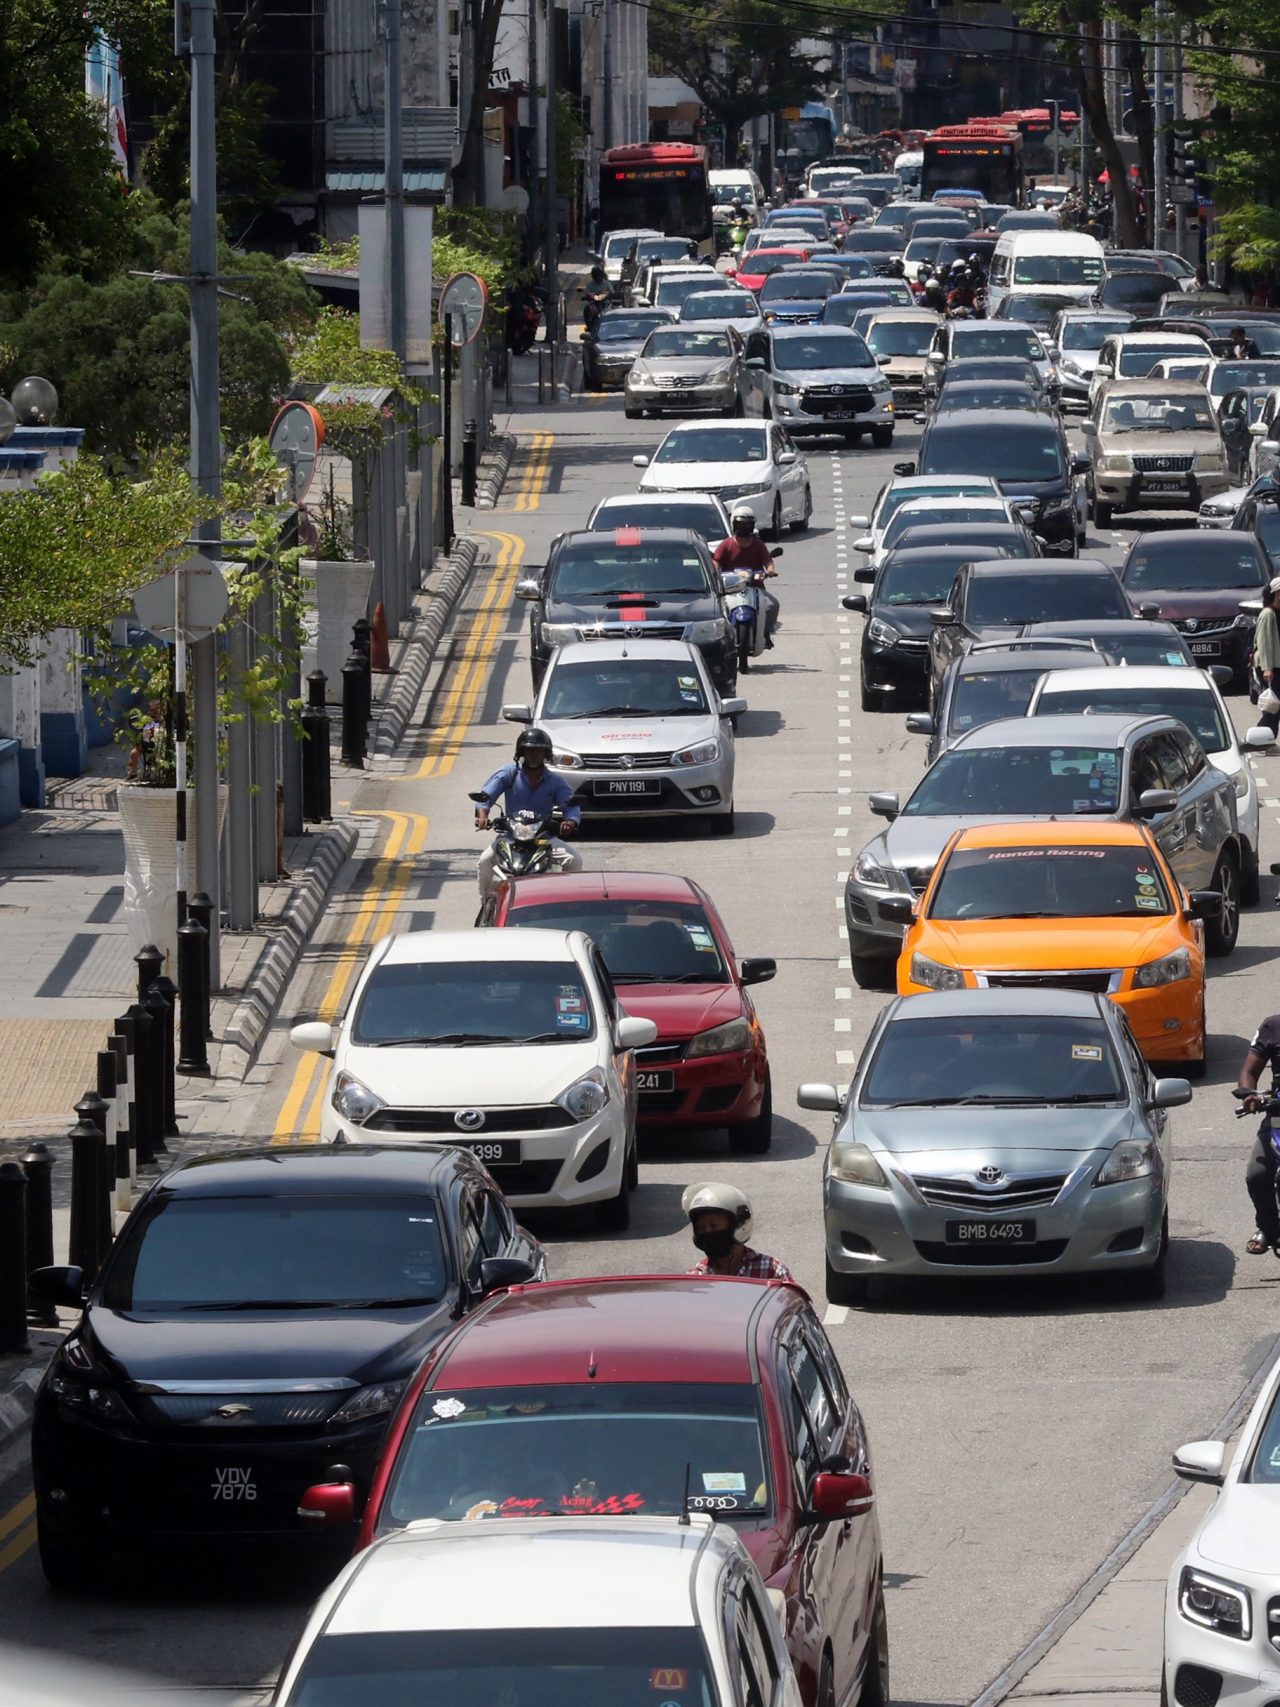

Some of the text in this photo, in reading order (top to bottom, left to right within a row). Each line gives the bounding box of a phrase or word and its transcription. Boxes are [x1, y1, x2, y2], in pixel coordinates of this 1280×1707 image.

[1191, 643, 1212, 653] 4884
[609, 780, 646, 793] PNV 1191
[987, 849, 1106, 860] Honda Racing
[637, 1073, 659, 1089] 241
[958, 1223, 1023, 1239] BMB 6493
[216, 1468, 251, 1484] VDV
[211, 1484, 256, 1500] 7876
